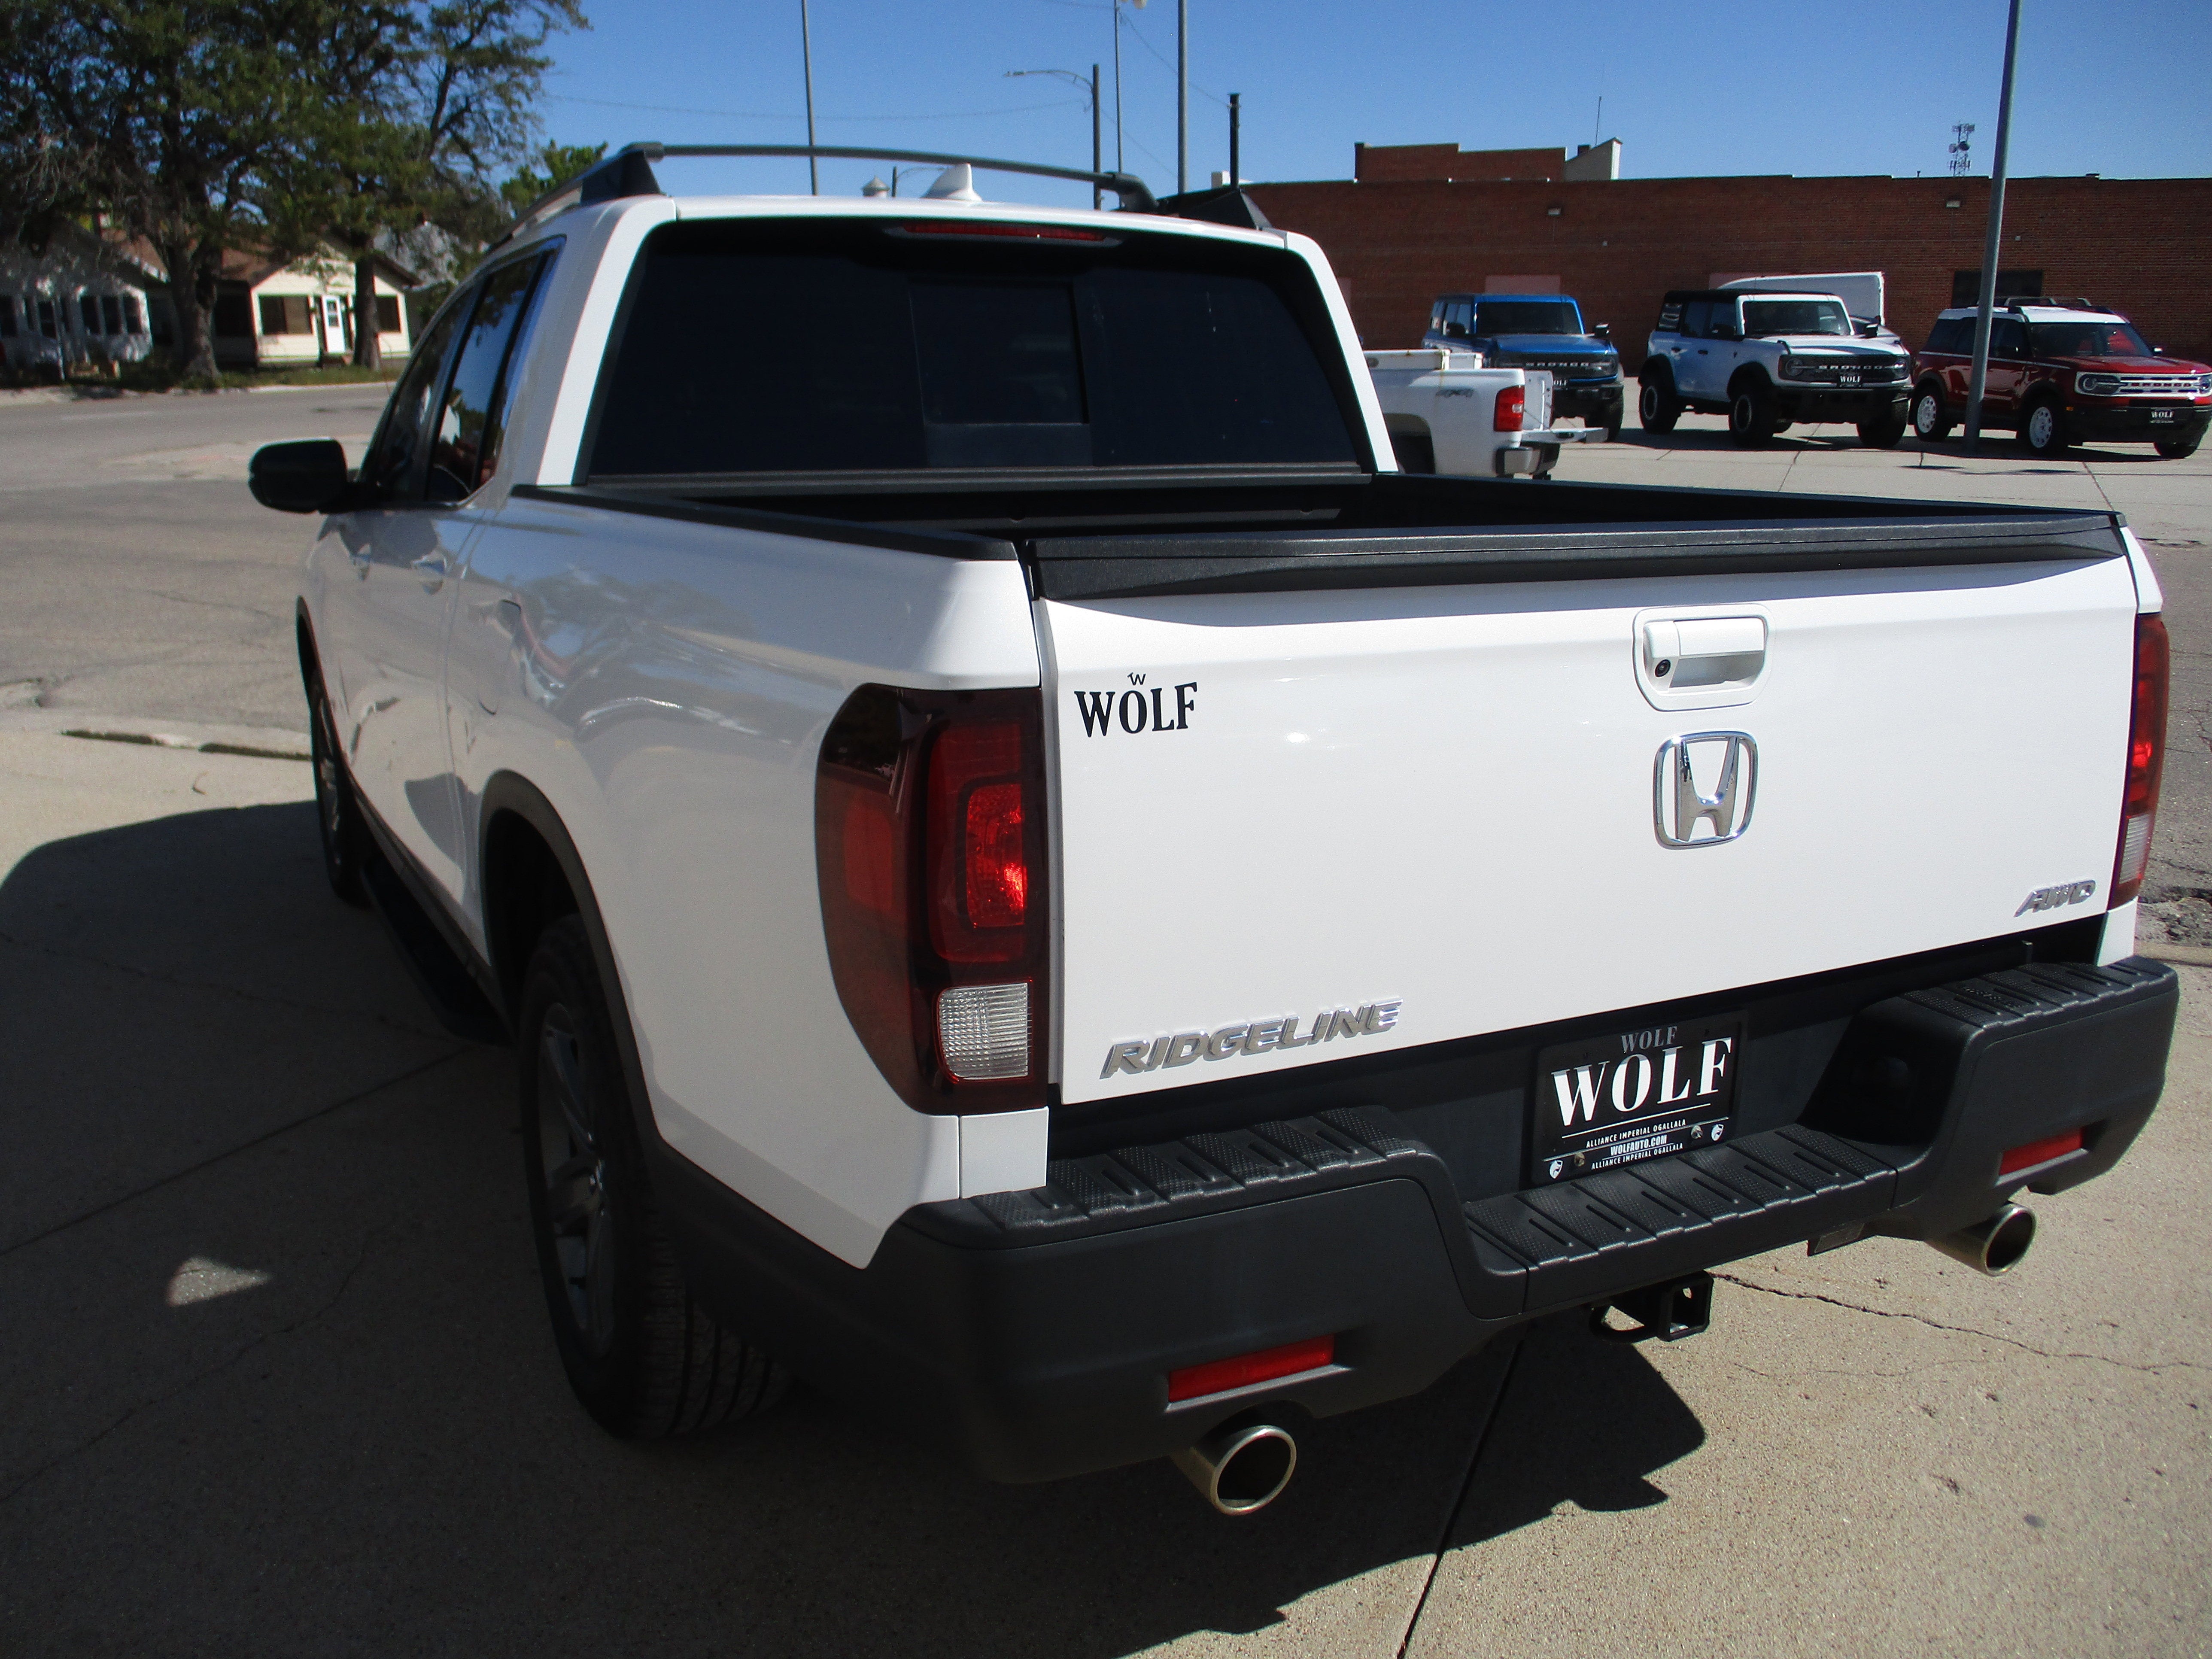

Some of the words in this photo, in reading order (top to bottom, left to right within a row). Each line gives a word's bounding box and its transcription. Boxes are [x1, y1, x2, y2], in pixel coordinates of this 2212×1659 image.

[1074, 682, 1197, 738] WOLF
[2013, 879, 2097, 918] AWD
[1099, 996, 1404, 1079] RIDGELINE
[1621, 1026, 1677, 1053] WOLF
[1550, 1037, 1732, 1126] WOLF
[1586, 1135, 1617, 1149] ALLIANCE
[1619, 1126, 1651, 1142] IMPERIAL
[1653, 1119, 1686, 1132] OGALLALA
[1610, 1134, 1667, 1156] WOLFAUTO.COM
[1591, 1157, 1621, 1170] ALLIANCE
[1623, 1150, 1652, 1164] IMPERIAL
[1653, 1143, 1683, 1156] OGALLALA
